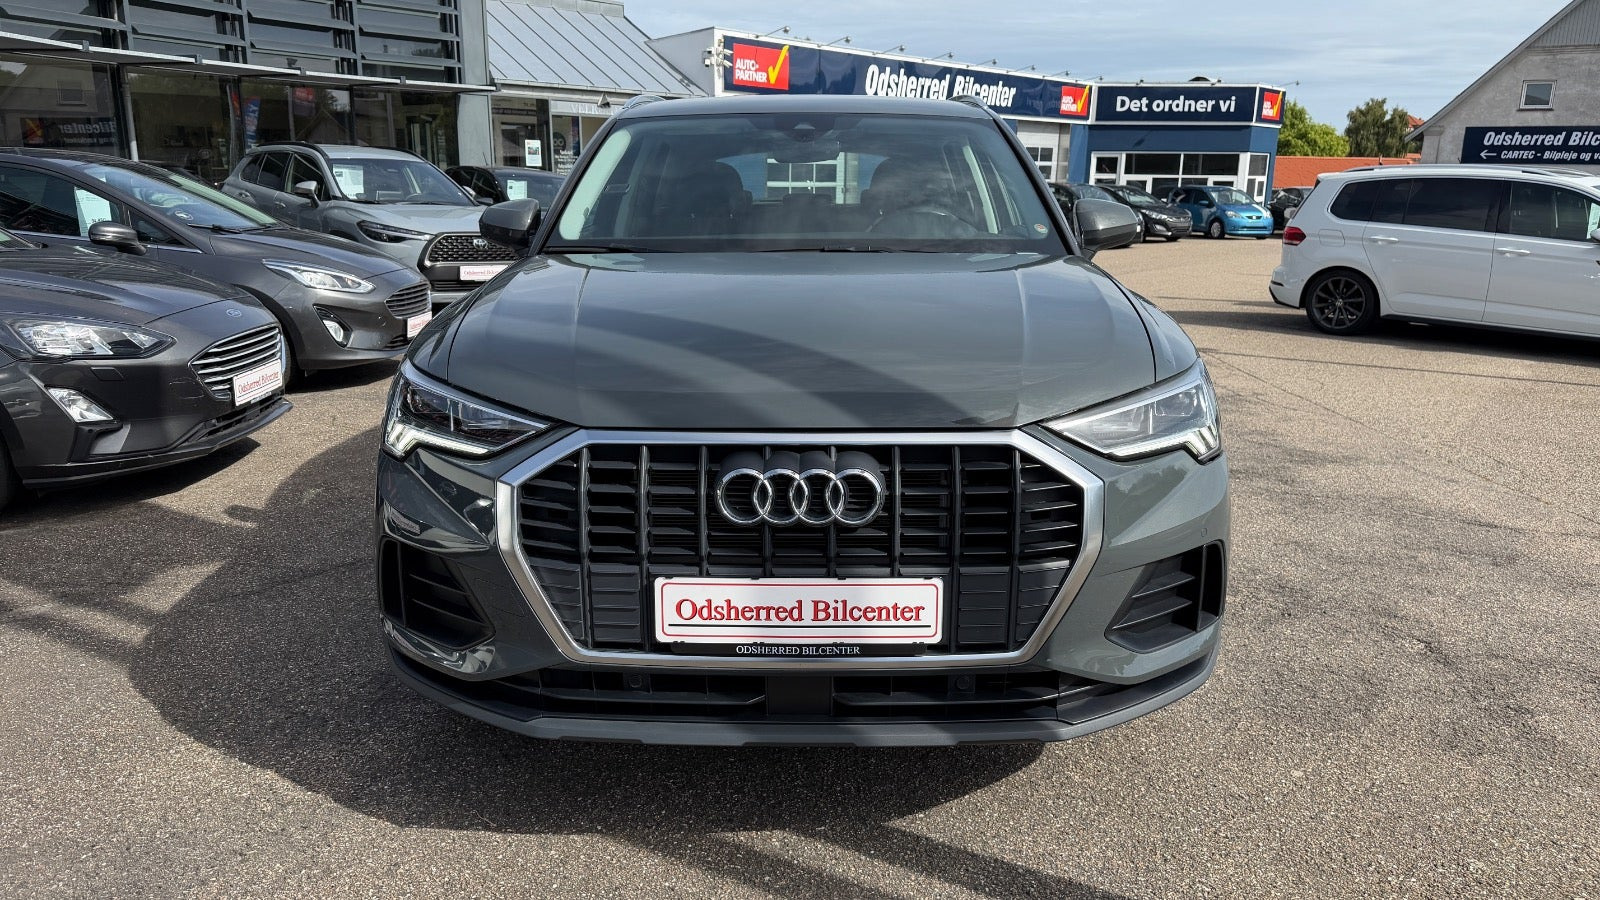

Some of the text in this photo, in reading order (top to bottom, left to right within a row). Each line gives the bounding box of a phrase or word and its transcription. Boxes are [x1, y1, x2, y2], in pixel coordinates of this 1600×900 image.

[736, 58, 759, 71] AUTO-
[735, 69, 768, 83] PARTNER
[865, 64, 1017, 108] Odsherred Bilcenter
[1115, 95, 1236, 113] Det ordner vi
[1483, 131, 1600, 146] Odsherred Bilc
[1500, 150, 1536, 160] CARTEC
[1543, 151, 1578, 161] Bilpleje
[1580, 152, 1592, 161] og
[675, 598, 925, 622] Odsherred Bilcenter
[735, 645, 861, 655] ODSHERRED BILCENTER
